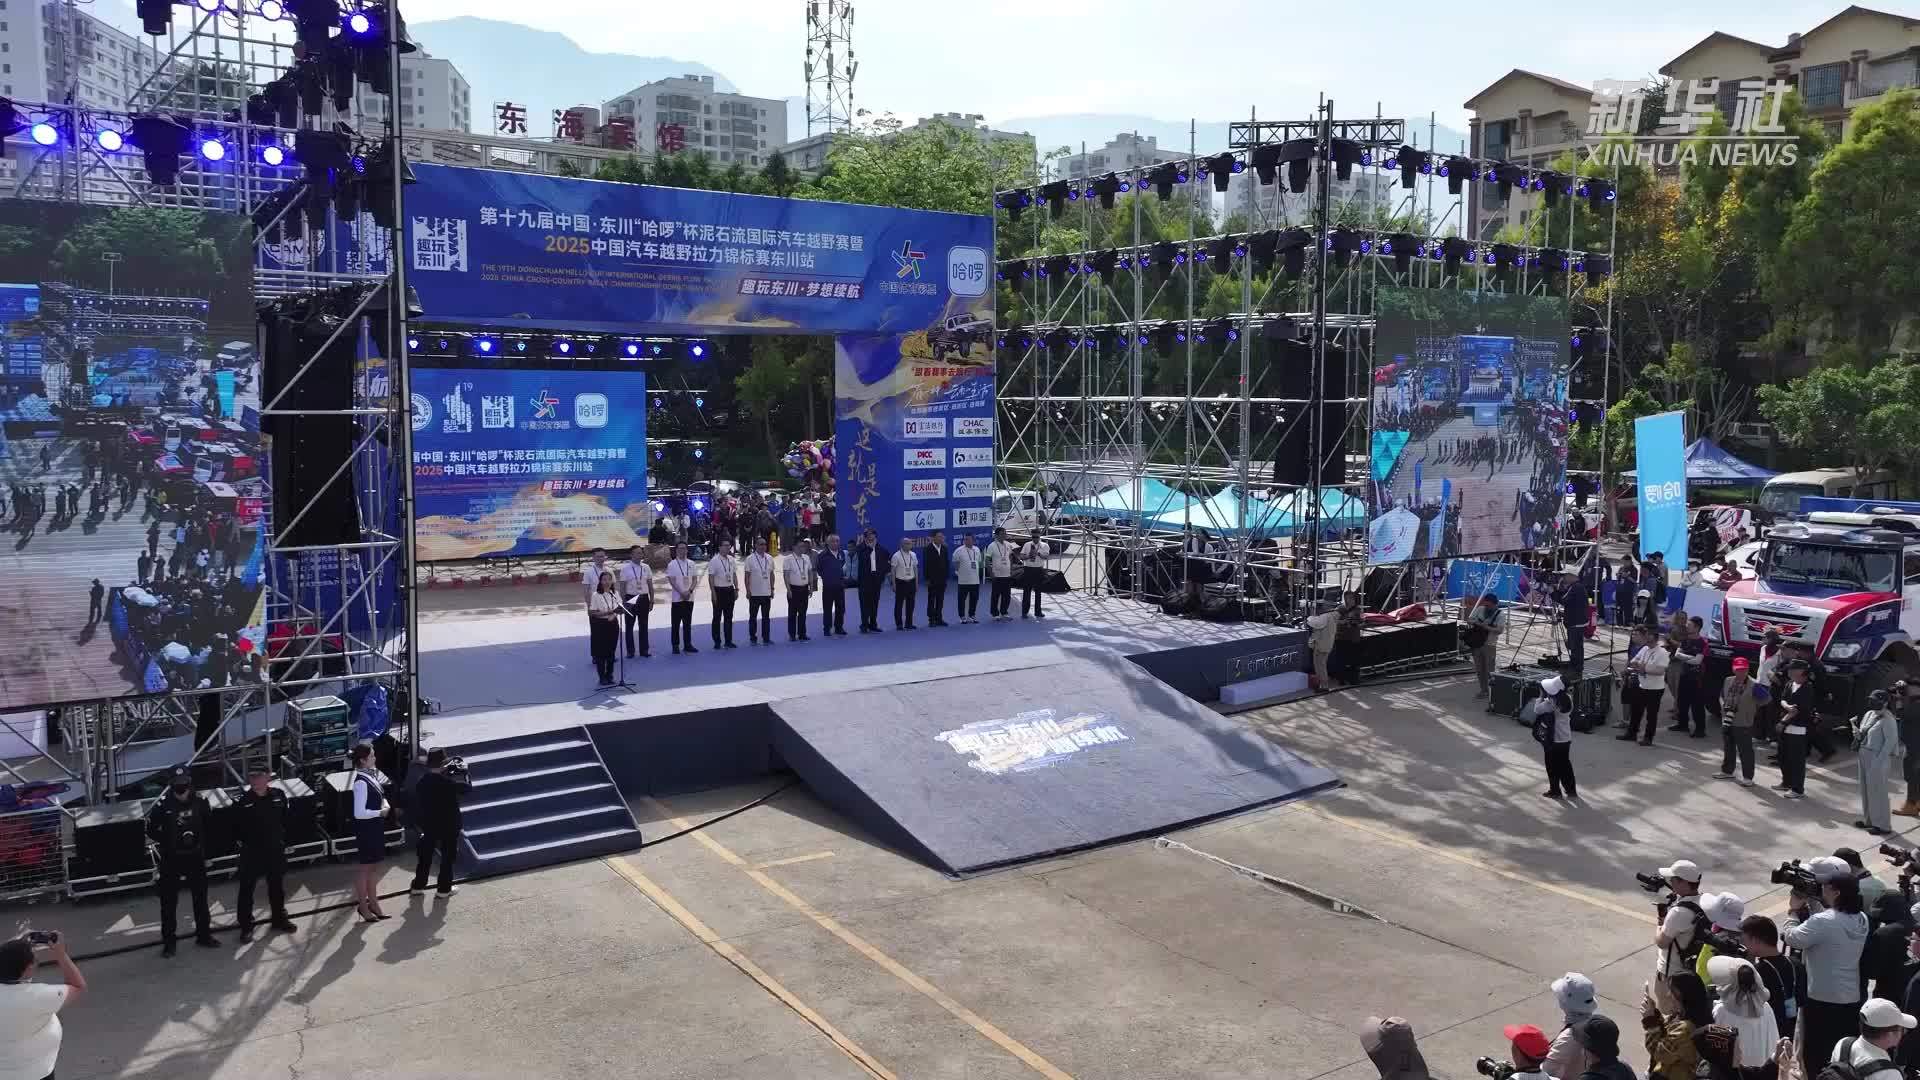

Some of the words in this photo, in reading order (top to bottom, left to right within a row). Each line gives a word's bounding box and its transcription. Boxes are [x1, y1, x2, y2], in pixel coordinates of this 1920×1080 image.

[496, 102, 685, 151] 东海宾馆
[416, 237, 446, 253] 趣玩
[544, 234, 816, 270] 2025中国汽车越野拉力锦标赛东川站
[416, 252, 446, 268] 东川
[952, 262, 984, 281] 哈啰
[740, 279, 861, 299] 趣玩东川·梦想续航
[463, 382, 474, 392] 19
[578, 404, 605, 417] 哈啰
[963, 419, 985, 427] CHAC
[917, 451, 933, 459] PICC
